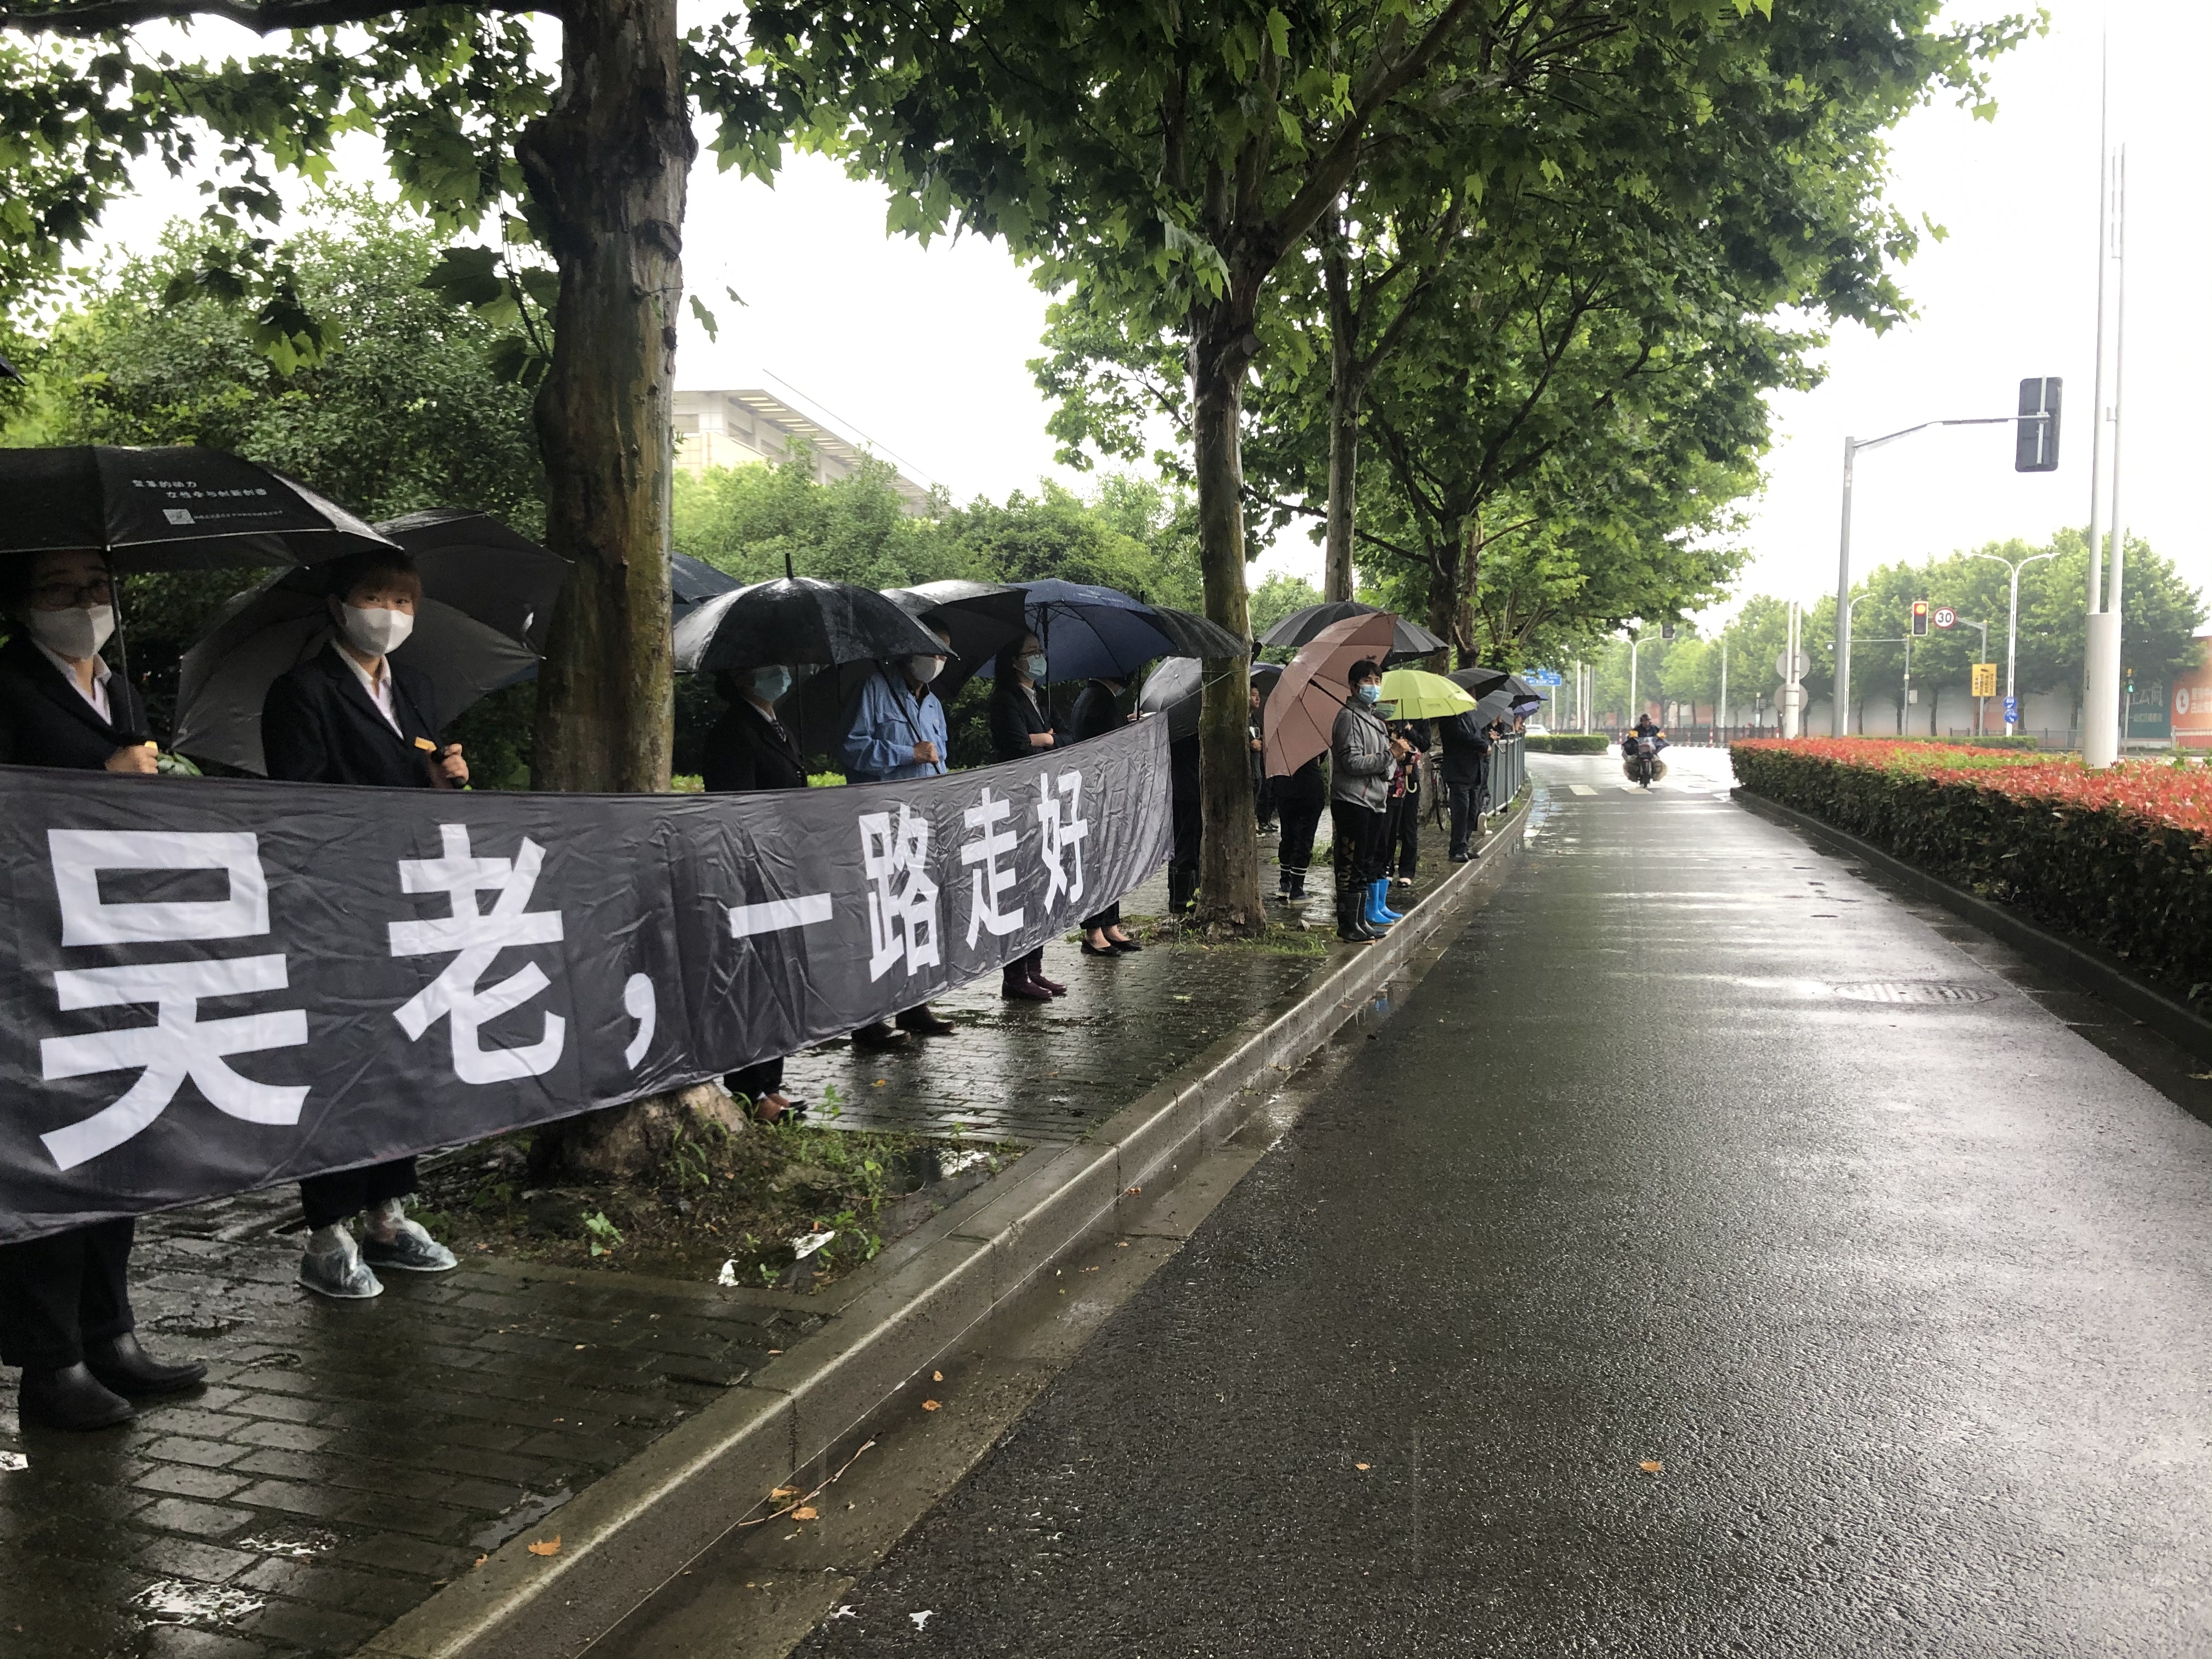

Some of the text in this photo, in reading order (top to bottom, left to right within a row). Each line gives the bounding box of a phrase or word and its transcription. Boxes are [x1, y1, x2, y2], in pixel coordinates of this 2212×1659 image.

[1938, 612, 1951, 623] 30
[40, 770, 1087, 1171] 吴老，一路走好
